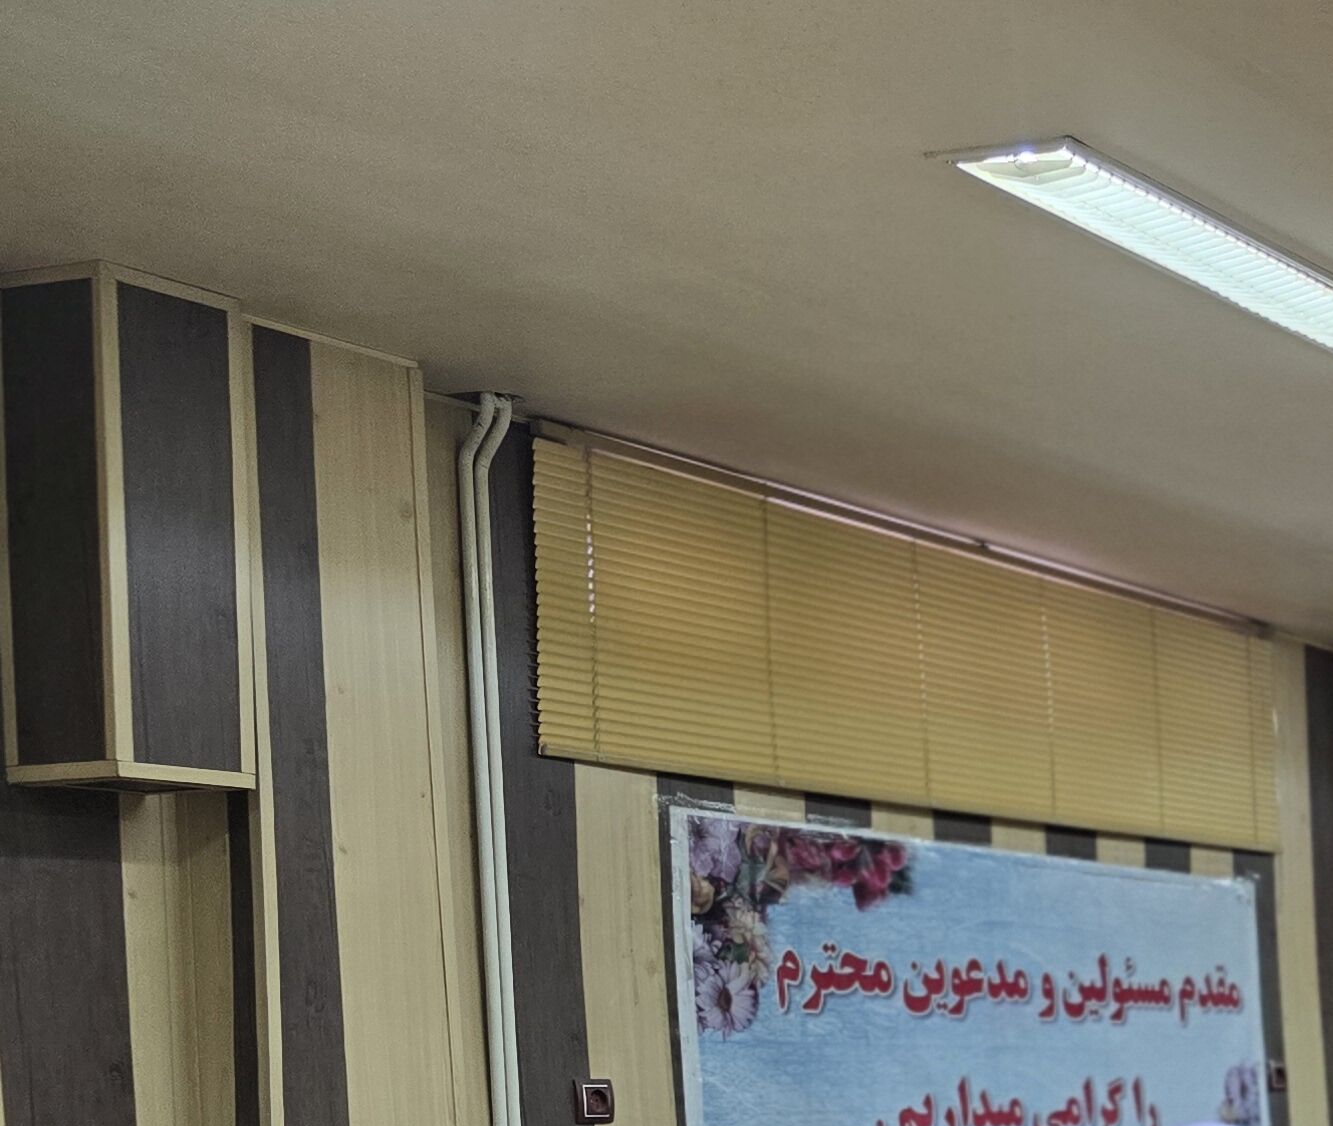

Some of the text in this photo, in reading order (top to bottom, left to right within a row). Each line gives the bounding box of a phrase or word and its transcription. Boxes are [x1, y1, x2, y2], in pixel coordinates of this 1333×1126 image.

[776, 943, 1241, 1023] مقدم مسئولین و مدعوین محترم
